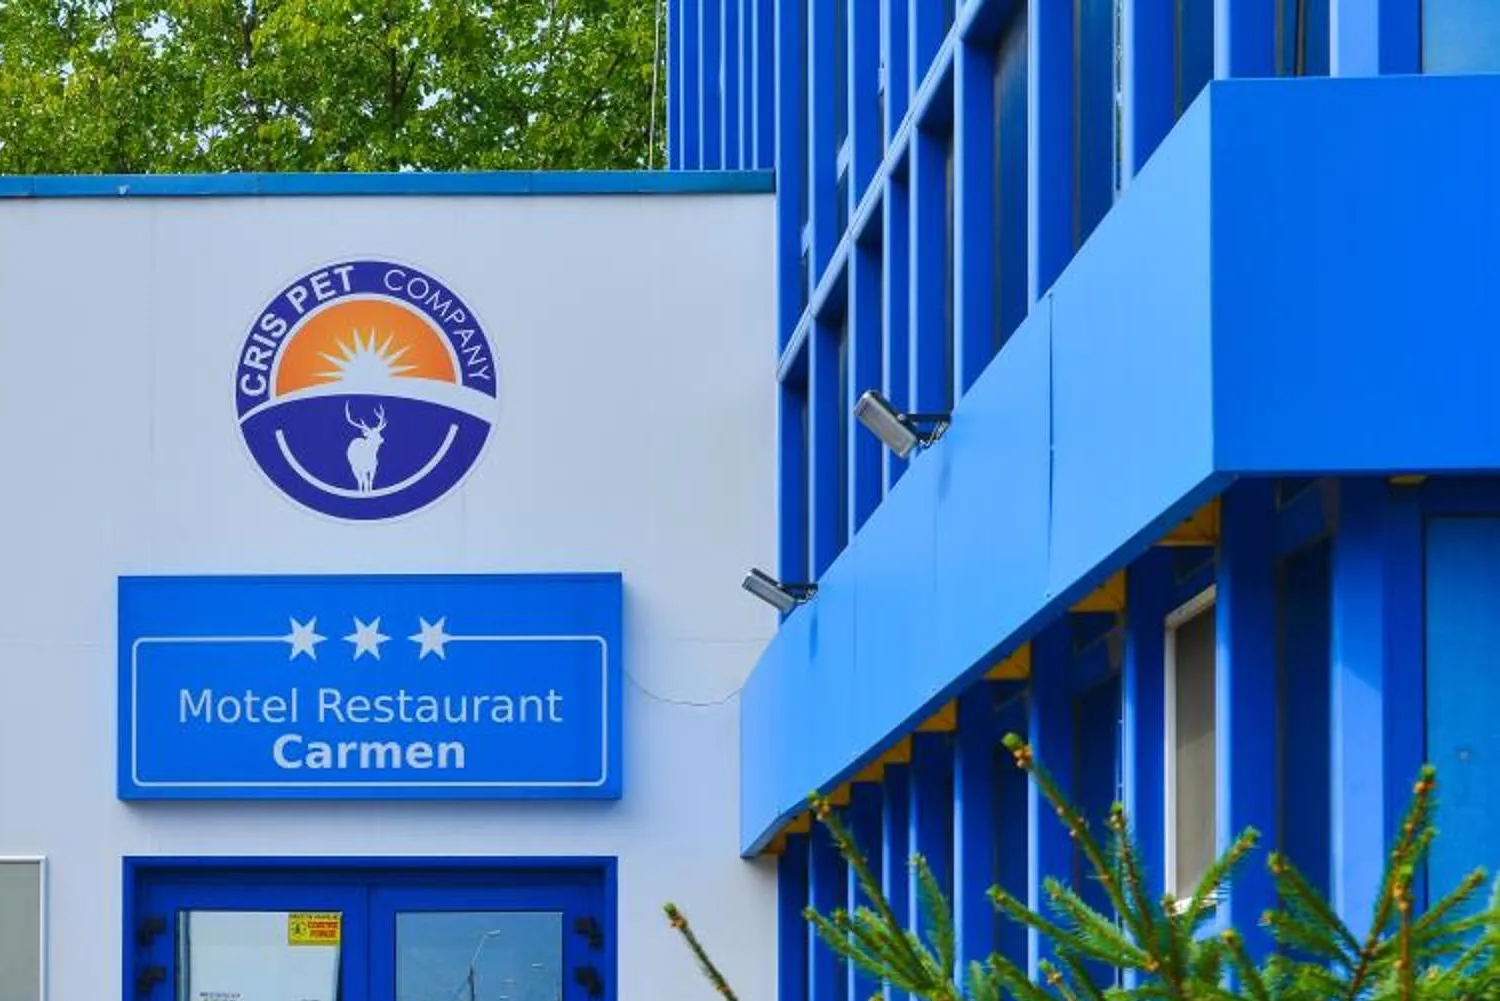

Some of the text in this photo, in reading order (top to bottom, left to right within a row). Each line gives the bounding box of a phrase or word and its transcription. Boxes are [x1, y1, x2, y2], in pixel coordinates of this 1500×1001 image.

[240, 265, 491, 397] CRIS PET COMPANY
[179, 687, 563, 723] Motel Restaurant
[272, 733, 466, 769] Carmen
